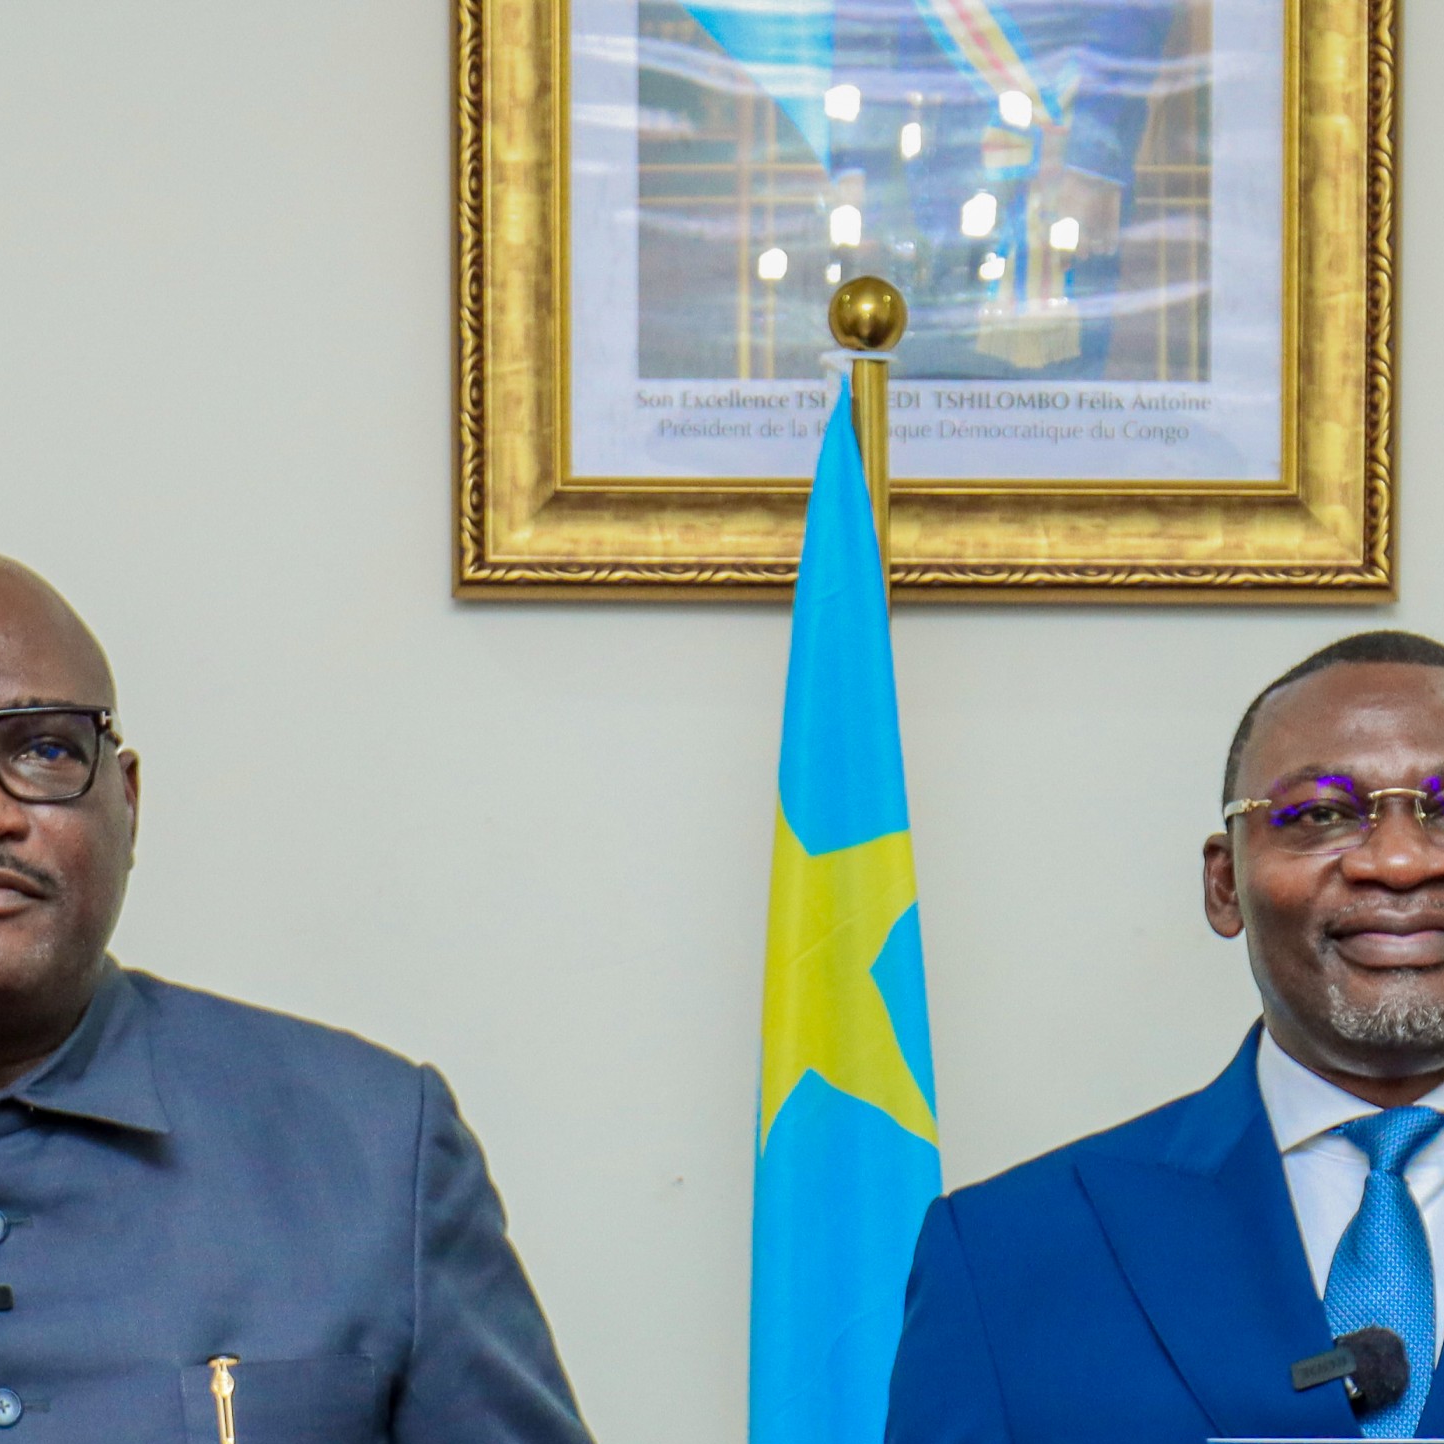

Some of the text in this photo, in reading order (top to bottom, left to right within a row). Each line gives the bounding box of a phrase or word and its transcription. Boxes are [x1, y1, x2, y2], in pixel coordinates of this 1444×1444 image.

[637, 389, 674, 409] Son
[682, 388, 790, 409] Excellence
[934, 390, 1071, 410] TSHILOMBO
[1078, 390, 1125, 410] Félix
[1131, 391, 1212, 410] Antoine
[659, 418, 751, 438] Président
[760, 418, 784, 438] de
[791, 418, 809, 438] la
[939, 419, 1084, 444] Démocratique
[1090, 420, 1116, 439] du
[1123, 420, 1190, 444] Congo
